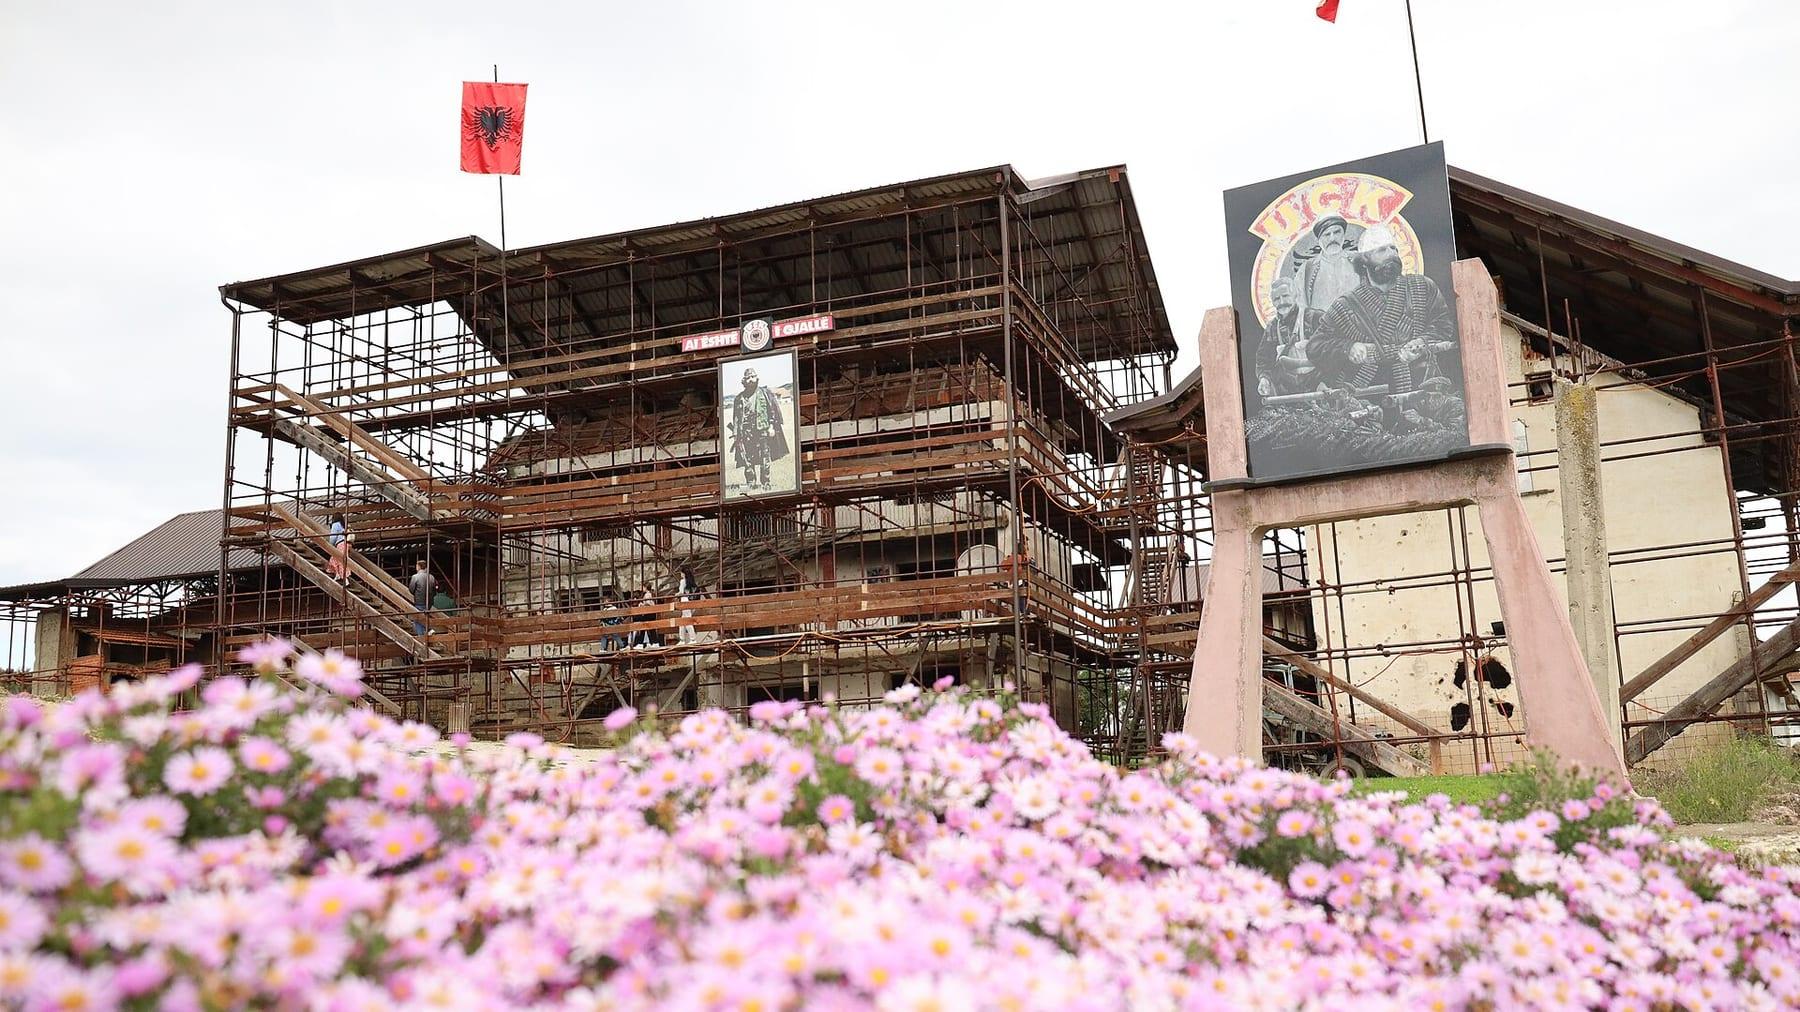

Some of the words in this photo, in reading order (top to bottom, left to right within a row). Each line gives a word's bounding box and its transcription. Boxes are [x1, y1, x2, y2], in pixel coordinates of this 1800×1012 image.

[685, 338, 700, 352] AI
[701, 331, 738, 348] ËSHTË
[783, 316, 829, 335] GJALLË
